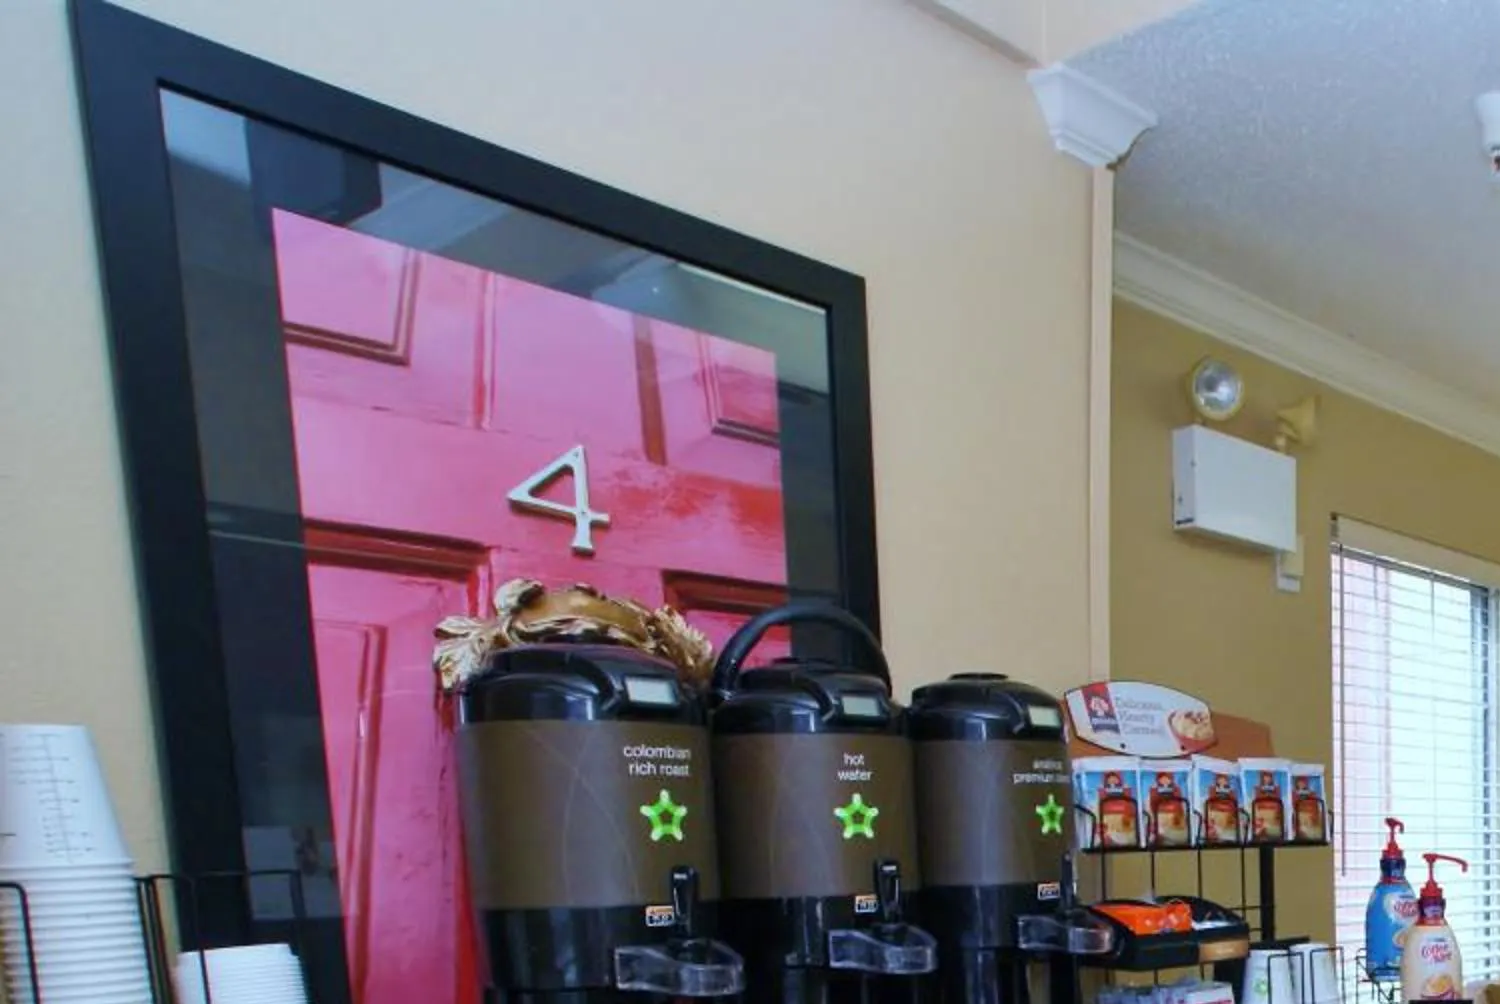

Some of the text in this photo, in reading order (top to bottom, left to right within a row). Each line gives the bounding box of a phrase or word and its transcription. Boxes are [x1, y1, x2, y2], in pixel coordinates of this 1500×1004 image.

[505, 443, 610, 549] 4
[623, 744, 691, 760] colombian
[843, 752, 865, 766] hot
[628, 761, 690, 776] rich roast
[837, 769, 872, 781] water
